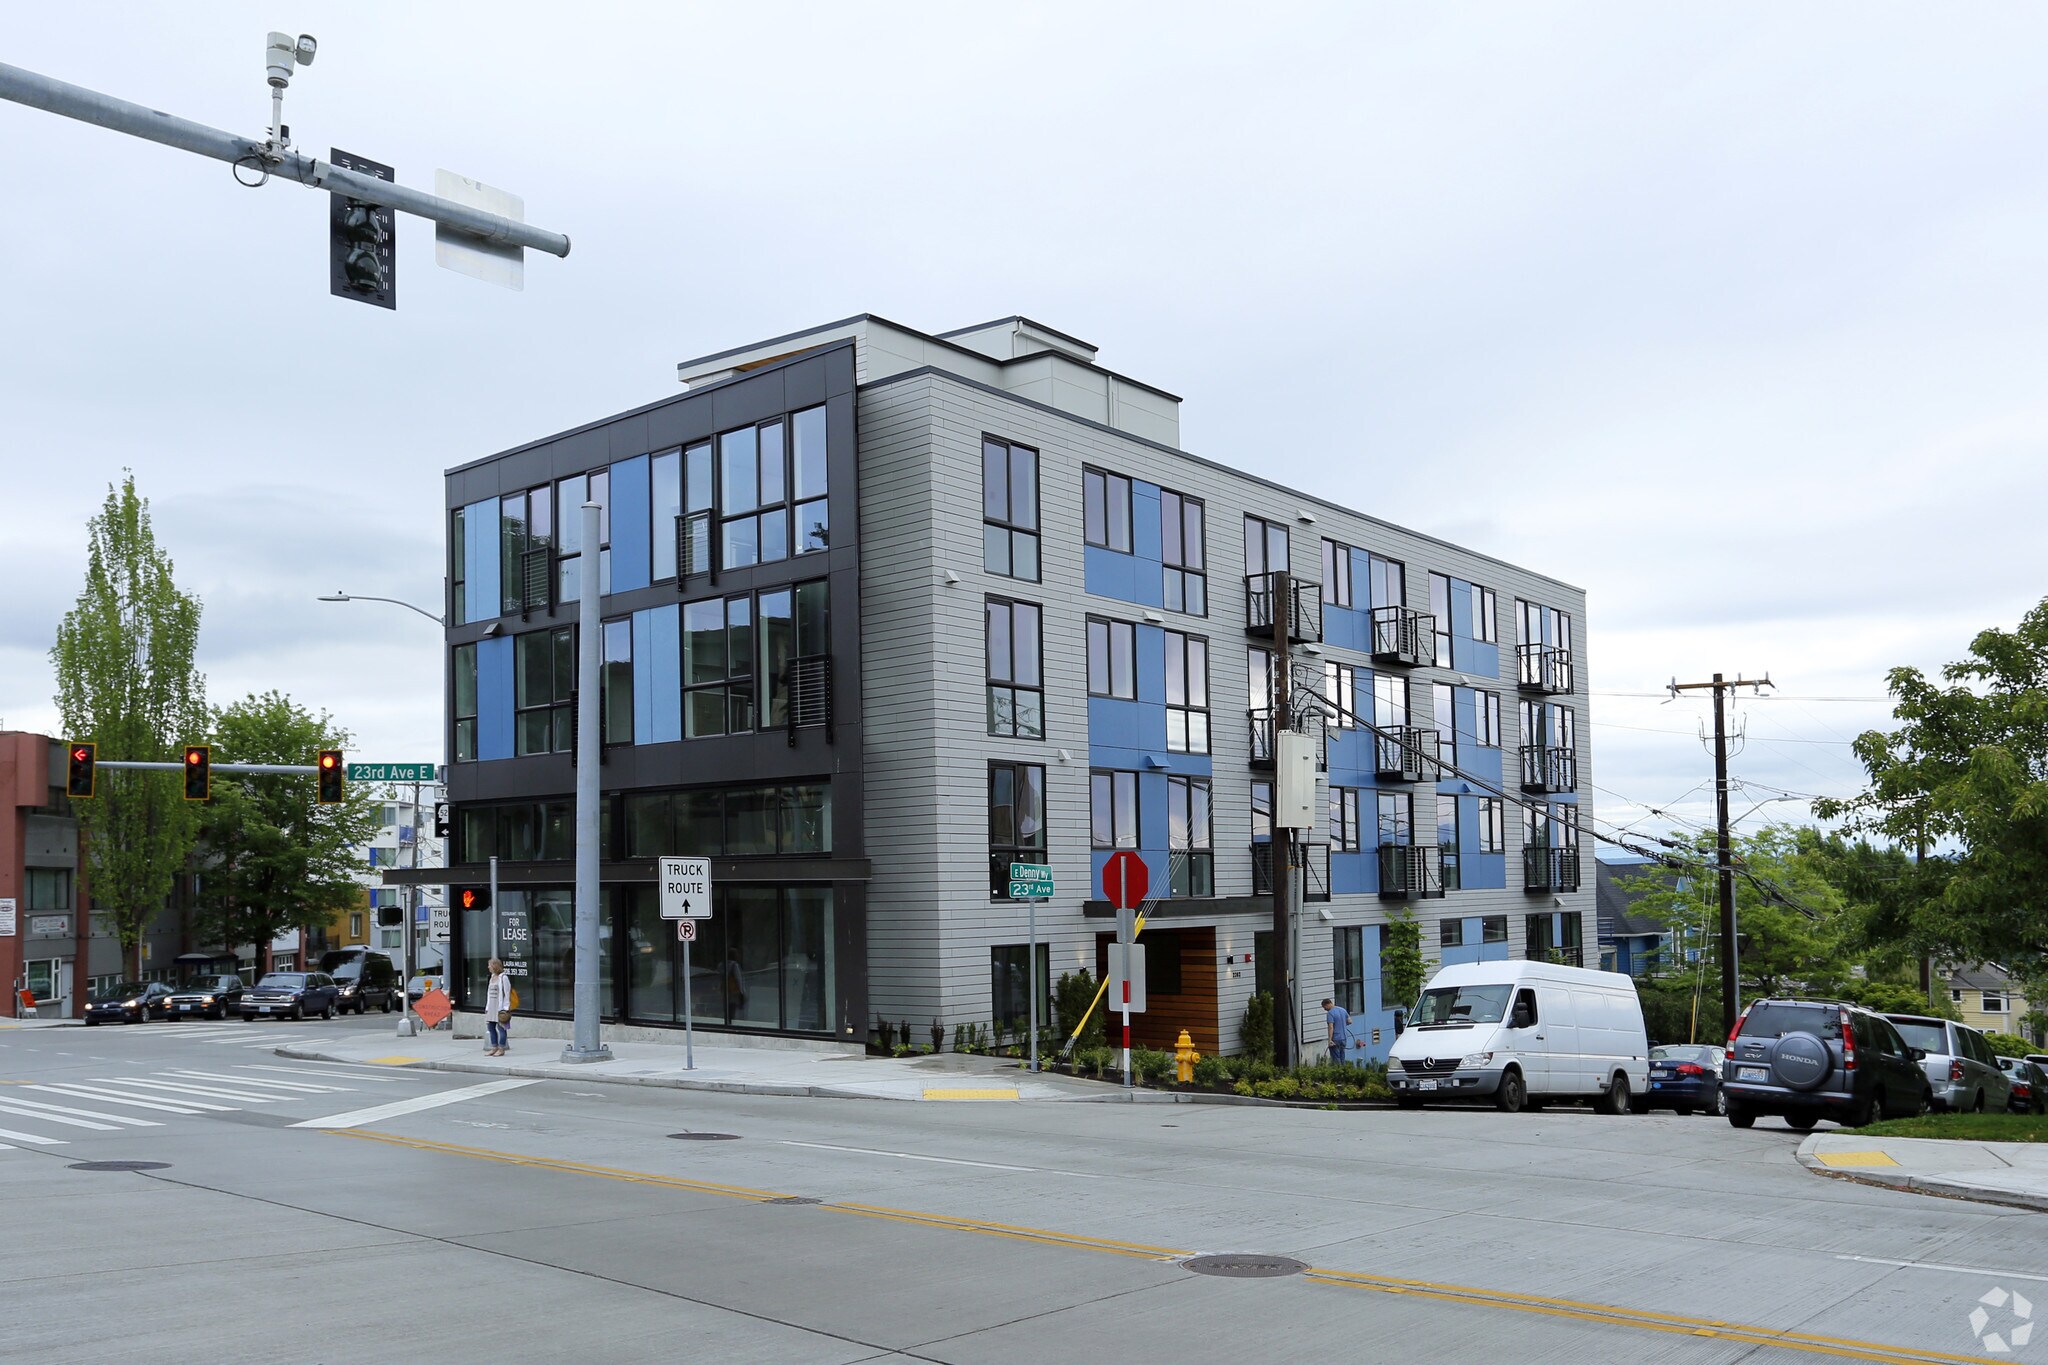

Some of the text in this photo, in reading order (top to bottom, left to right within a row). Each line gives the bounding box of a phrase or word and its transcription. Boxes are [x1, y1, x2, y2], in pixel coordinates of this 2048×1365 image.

[354, 765, 428, 779] 23rd Ave E
[440, 809, 448, 817] 52
[667, 864, 703, 876] TRUCK
[1014, 868, 1018, 877] E
[1019, 865, 1040, 880] Denny
[668, 882, 704, 894] ROUTE
[1013, 883, 1051, 896] 23rd Ave
[508, 917, 520, 927] FOR
[502, 928, 527, 941] LEASE
[1781, 1053, 1819, 1066] HONDA
